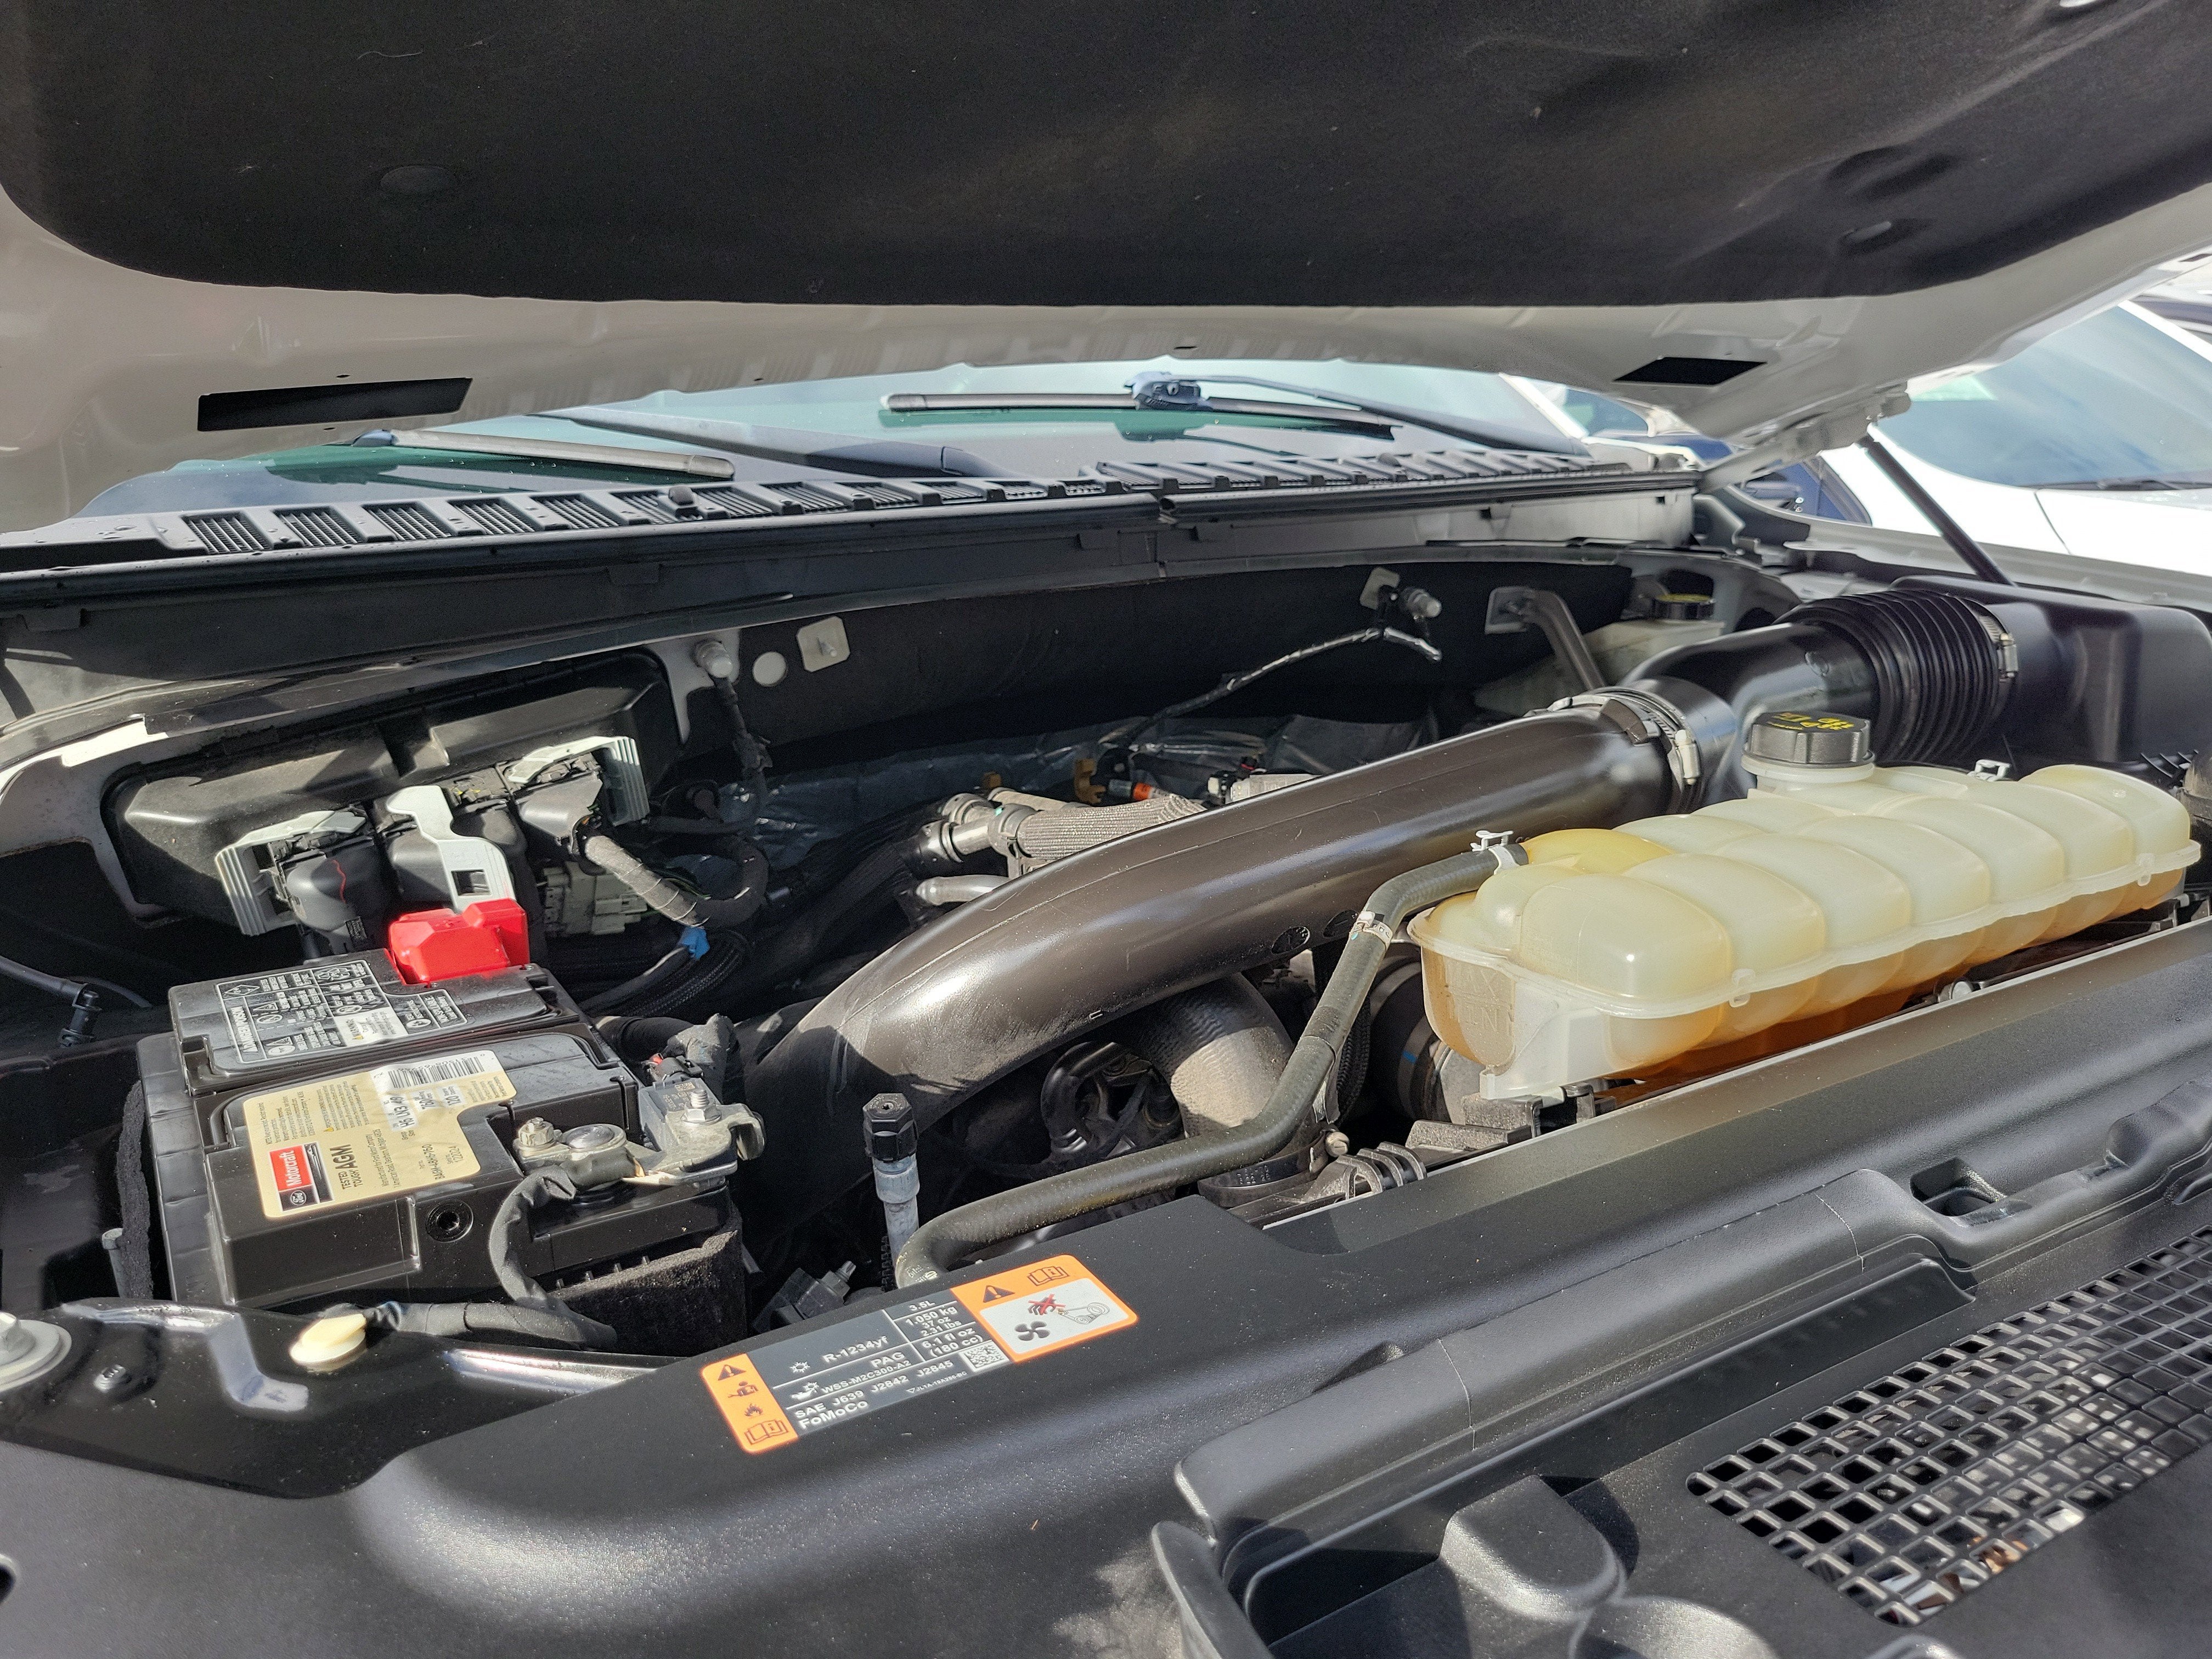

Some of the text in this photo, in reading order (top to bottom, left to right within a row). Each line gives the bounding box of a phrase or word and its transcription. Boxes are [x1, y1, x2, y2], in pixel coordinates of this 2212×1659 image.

[419, 1098, 436, 1109] 760
[445, 1094, 462, 1105] 120
[390, 1094, 415, 1128] H6 LN3 48
[330, 1143, 358, 1172] AGM
[448, 1144, 464, 1162] 122024
[278, 1149, 303, 1187] Motorcraft
[337, 1170, 352, 1190] TESTED
[290, 1190, 306, 1205] Ford
[906, 1306, 958, 1326] 1.050 kg
[909, 1301, 935, 1311] 3.5L
[921, 1321, 962, 1336] 2.31 lbs
[922, 1320, 934, 1328] 37
[922, 1328, 975, 1348] 6.1 fl oz
[930, 1335, 983, 1357] (180 cc)
[822, 1335, 888, 1362] R-1234yf
[871, 1352, 905, 1368] PAG
[821, 1360, 912, 1393] WSS-M2C300-A2
[795, 1360, 953, 1418] SAE J639 J2842 J2845
[798, 1401, 868, 1429] FoMoCo
